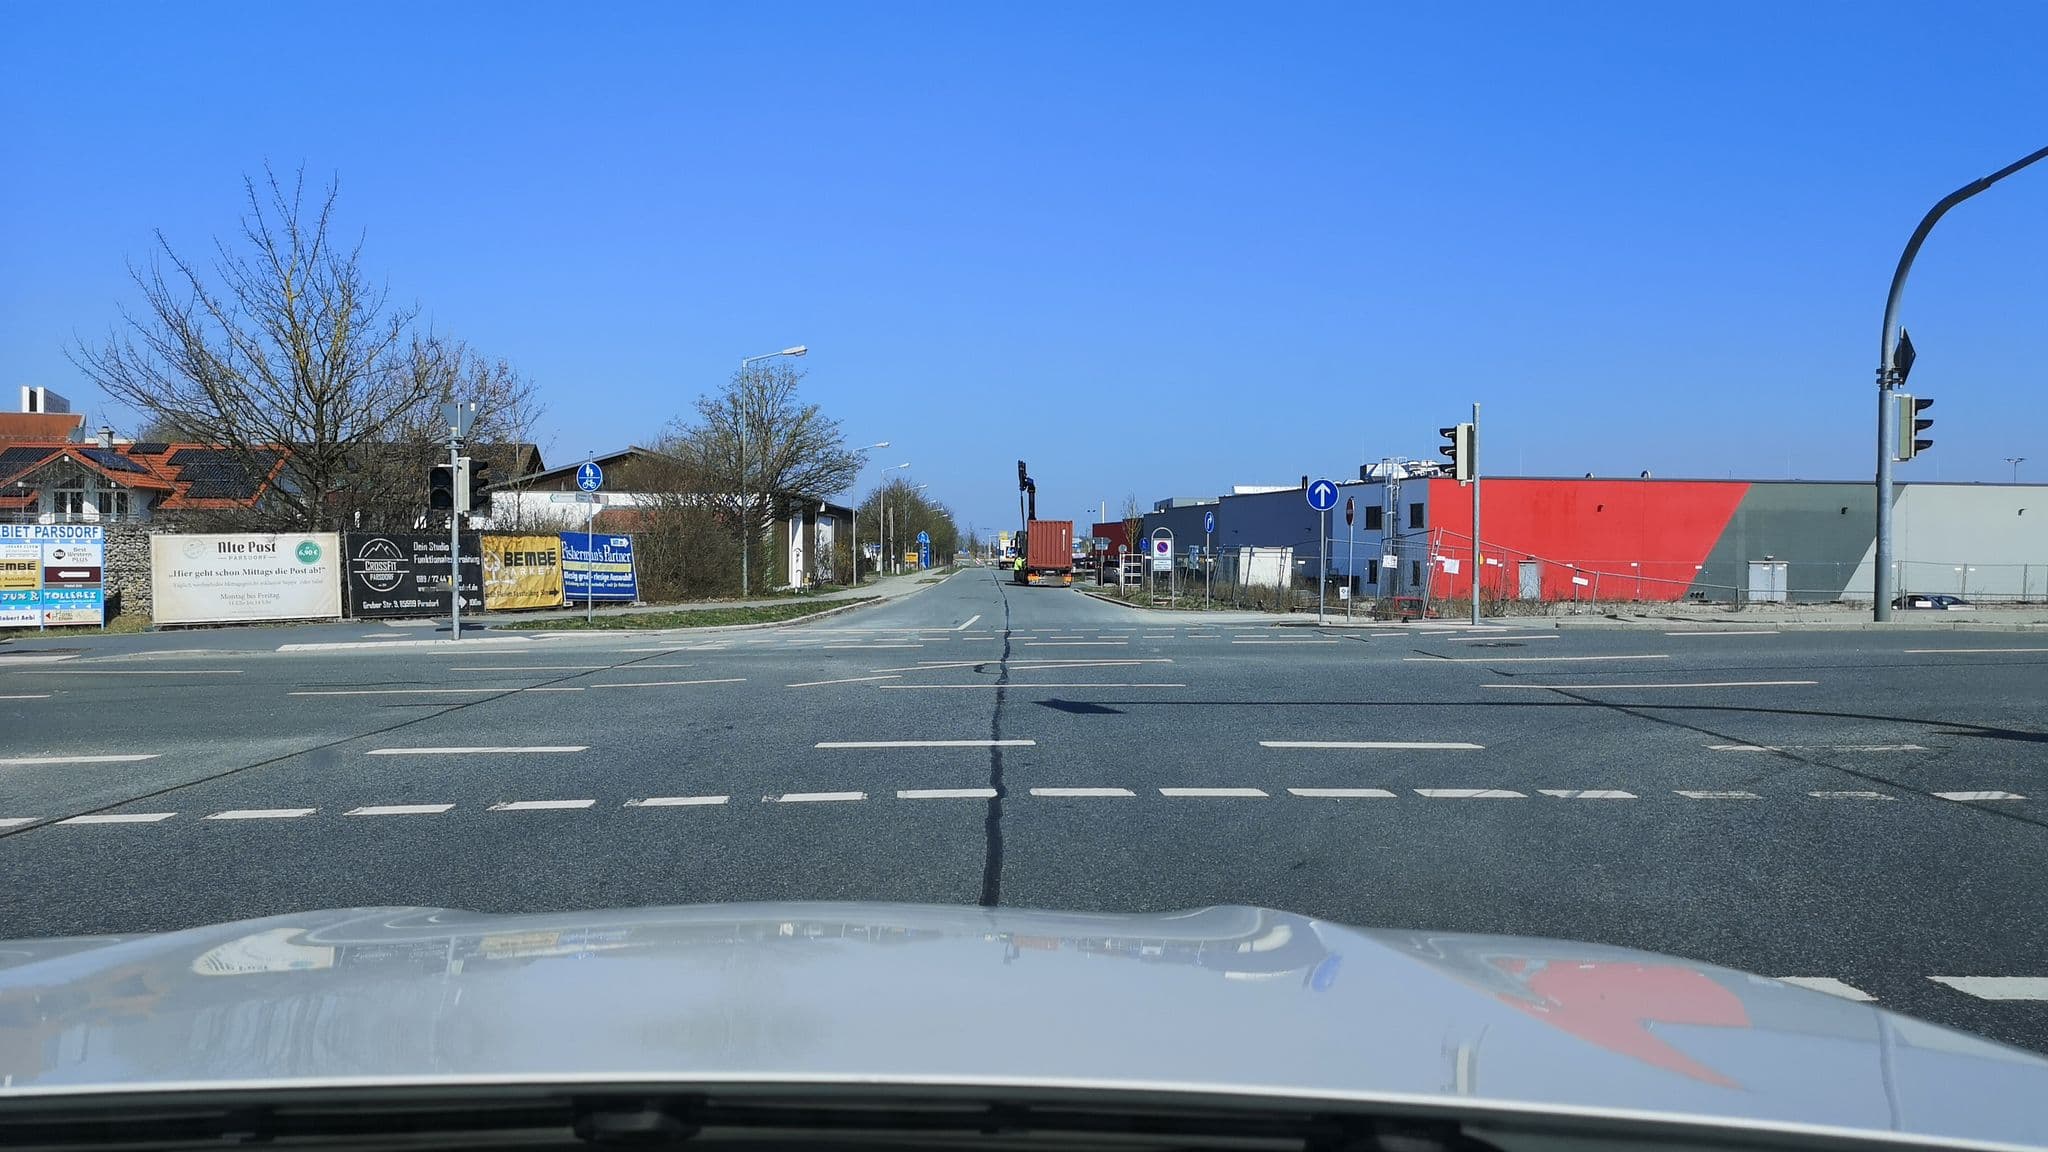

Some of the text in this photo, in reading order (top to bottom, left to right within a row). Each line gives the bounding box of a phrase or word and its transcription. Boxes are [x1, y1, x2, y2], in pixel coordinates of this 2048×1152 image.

[0, 526, 98, 538] BIET PARSDORF
[218, 541, 276, 553] Alte Post
[413, 542, 427, 551] Dein
[429, 542, 450, 551] Studio
[603, 545, 631, 562] Partner
[458, 555, 480, 565] raining
[194, 569, 213, 579] geht
[215, 569, 240, 577] schon
[241, 568, 273, 577] Mittags
[275, 567, 288, 575] die
[289, 567, 307, 575] Post
[30, 591, 40, 601] &
[417, 599, 440, 607] Parsdorf
